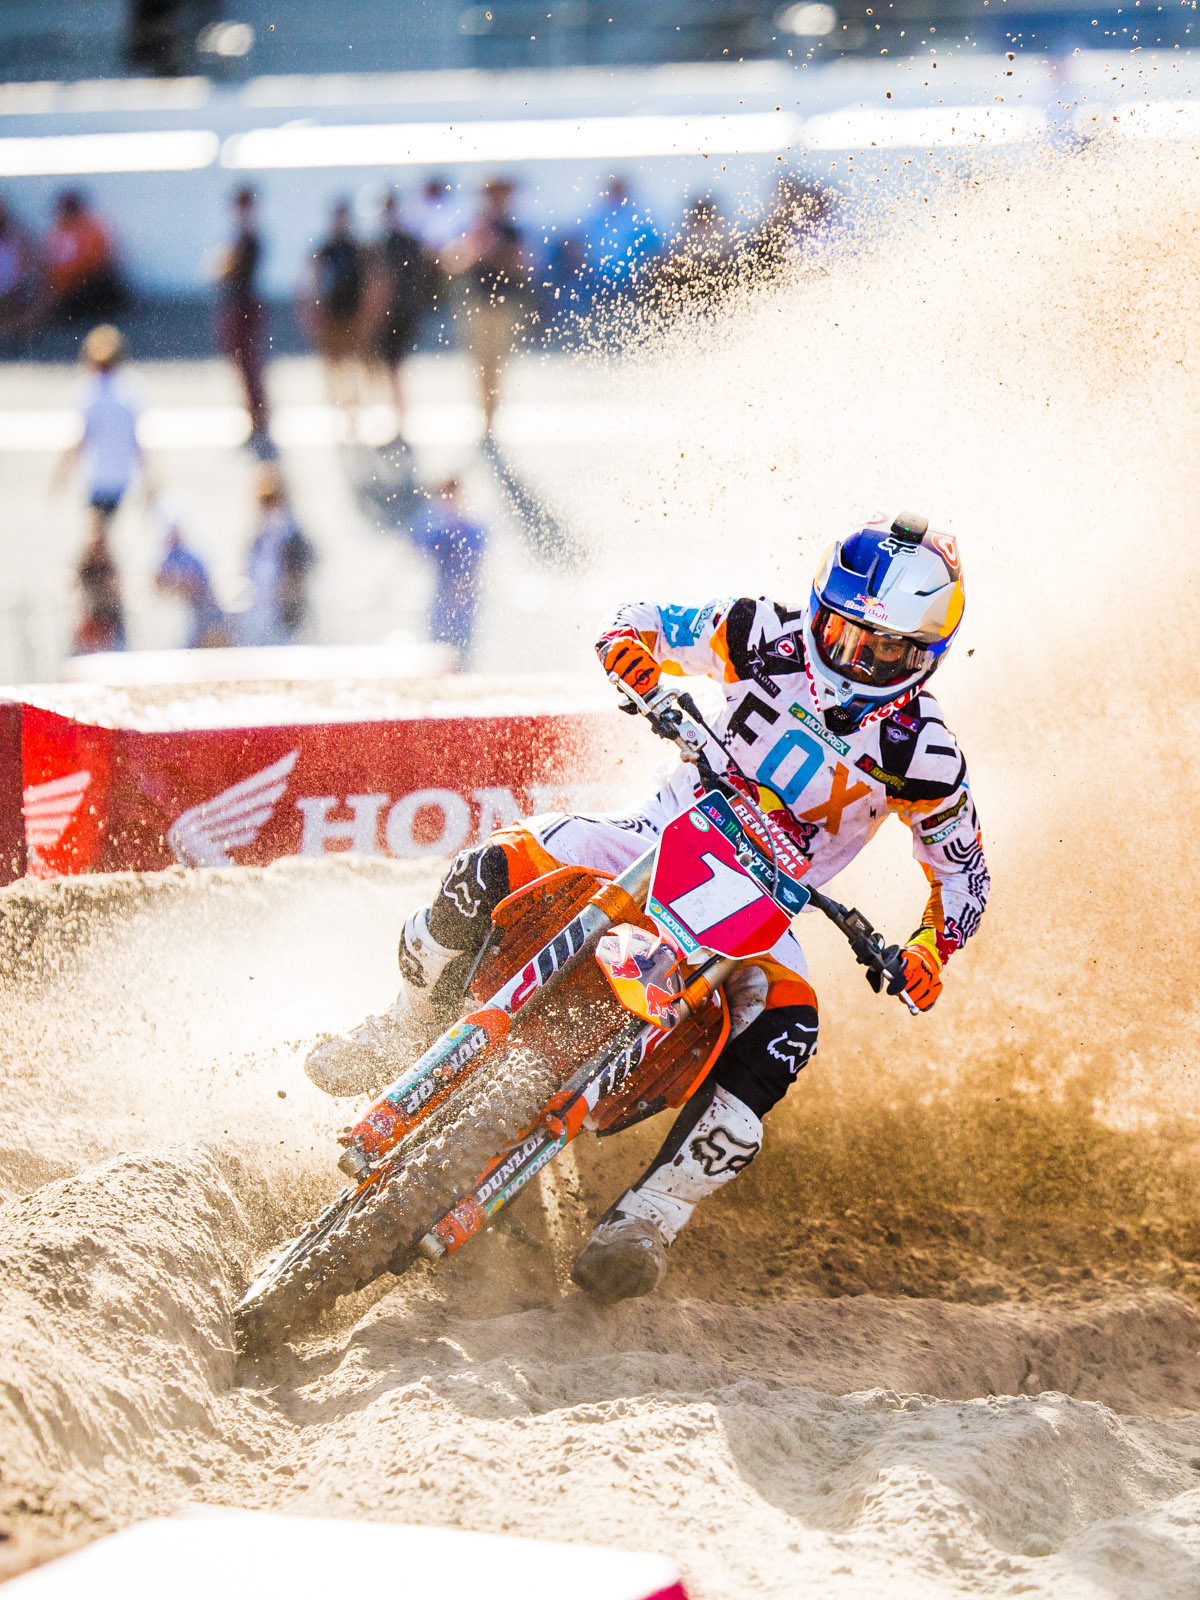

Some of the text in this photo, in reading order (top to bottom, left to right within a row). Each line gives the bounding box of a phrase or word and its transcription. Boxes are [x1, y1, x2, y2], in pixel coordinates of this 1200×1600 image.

[844, 600, 889, 621] Red Bull
[804, 714, 849, 756] MOTOREX
[727, 690, 873, 836] FOX
[667, 850, 766, 936] 1
[659, 911, 699, 951] MOTOREX
[504, 1138, 565, 1200] MOTOREX
